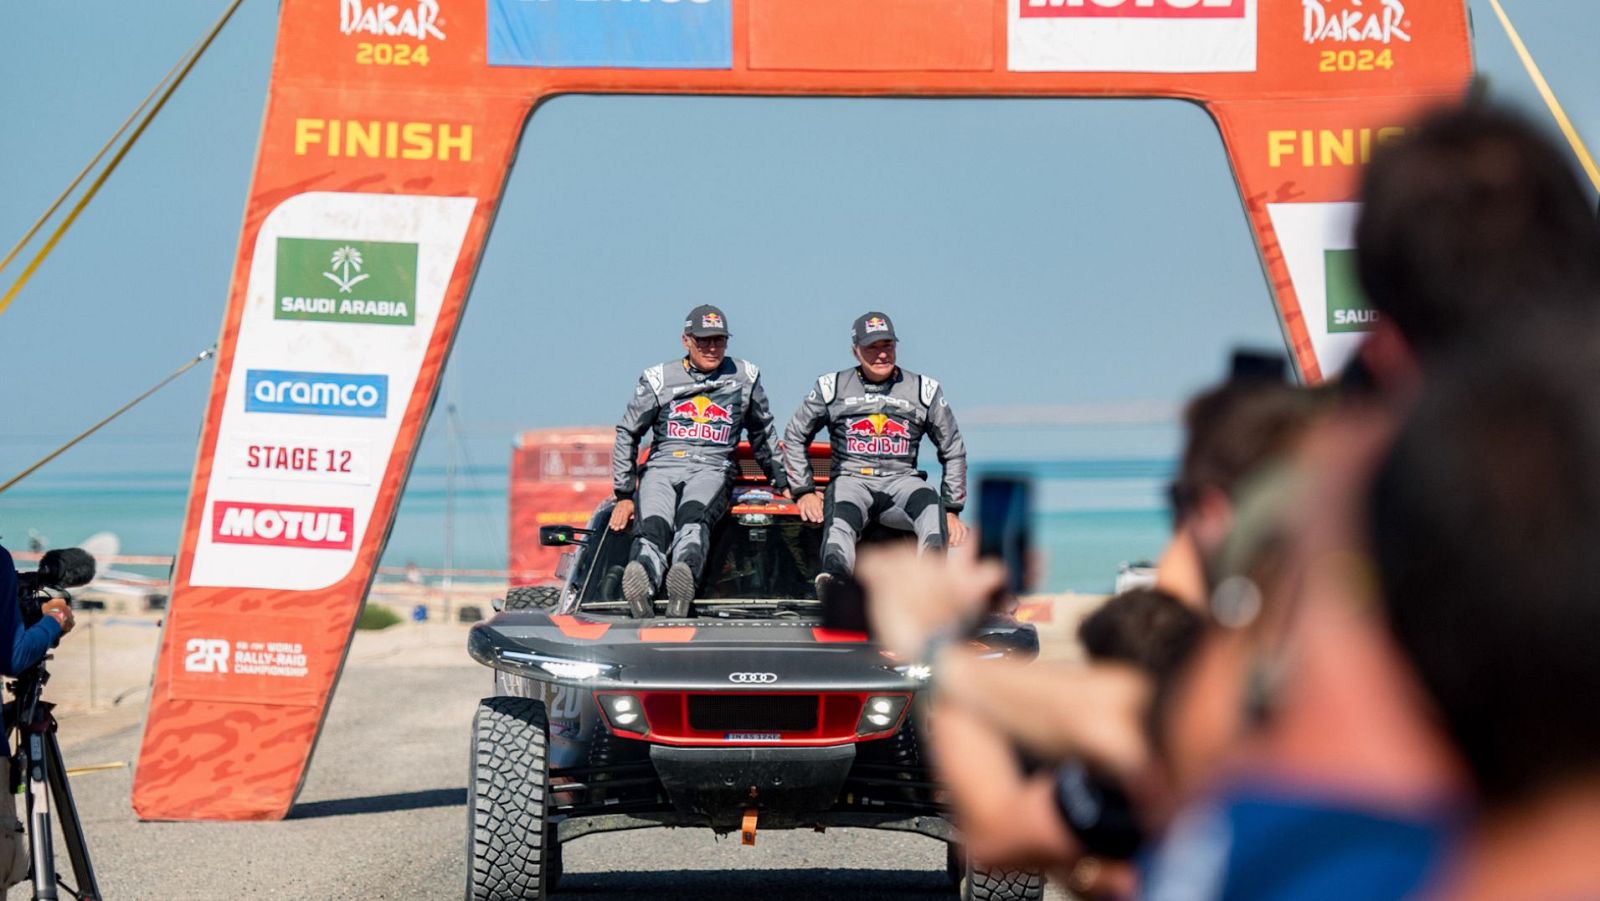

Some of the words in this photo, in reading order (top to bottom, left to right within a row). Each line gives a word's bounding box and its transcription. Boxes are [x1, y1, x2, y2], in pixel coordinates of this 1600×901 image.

[339, 0, 446, 40] DAKAR
[1302, 0, 1411, 44] DAKAR
[356, 42, 430, 66] 2024
[1319, 48, 1394, 72] 2024
[294, 118, 473, 162] FINISH
[281, 296, 336, 313] SAUDI
[339, 299, 408, 317] ARABIA
[1333, 309, 1379, 325] SAUD
[254, 379, 379, 408] aramco
[667, 421, 700, 439] Red
[701, 422, 732, 445] Bull
[846, 436, 879, 455] Red
[880, 436, 910, 456] Bull
[247, 445, 318, 471] STAGE
[326, 449, 352, 473] 12
[219, 507, 347, 543] MOTUL
[234, 650, 307, 668] RALLY-RAID
[266, 642, 303, 654] WORLD
